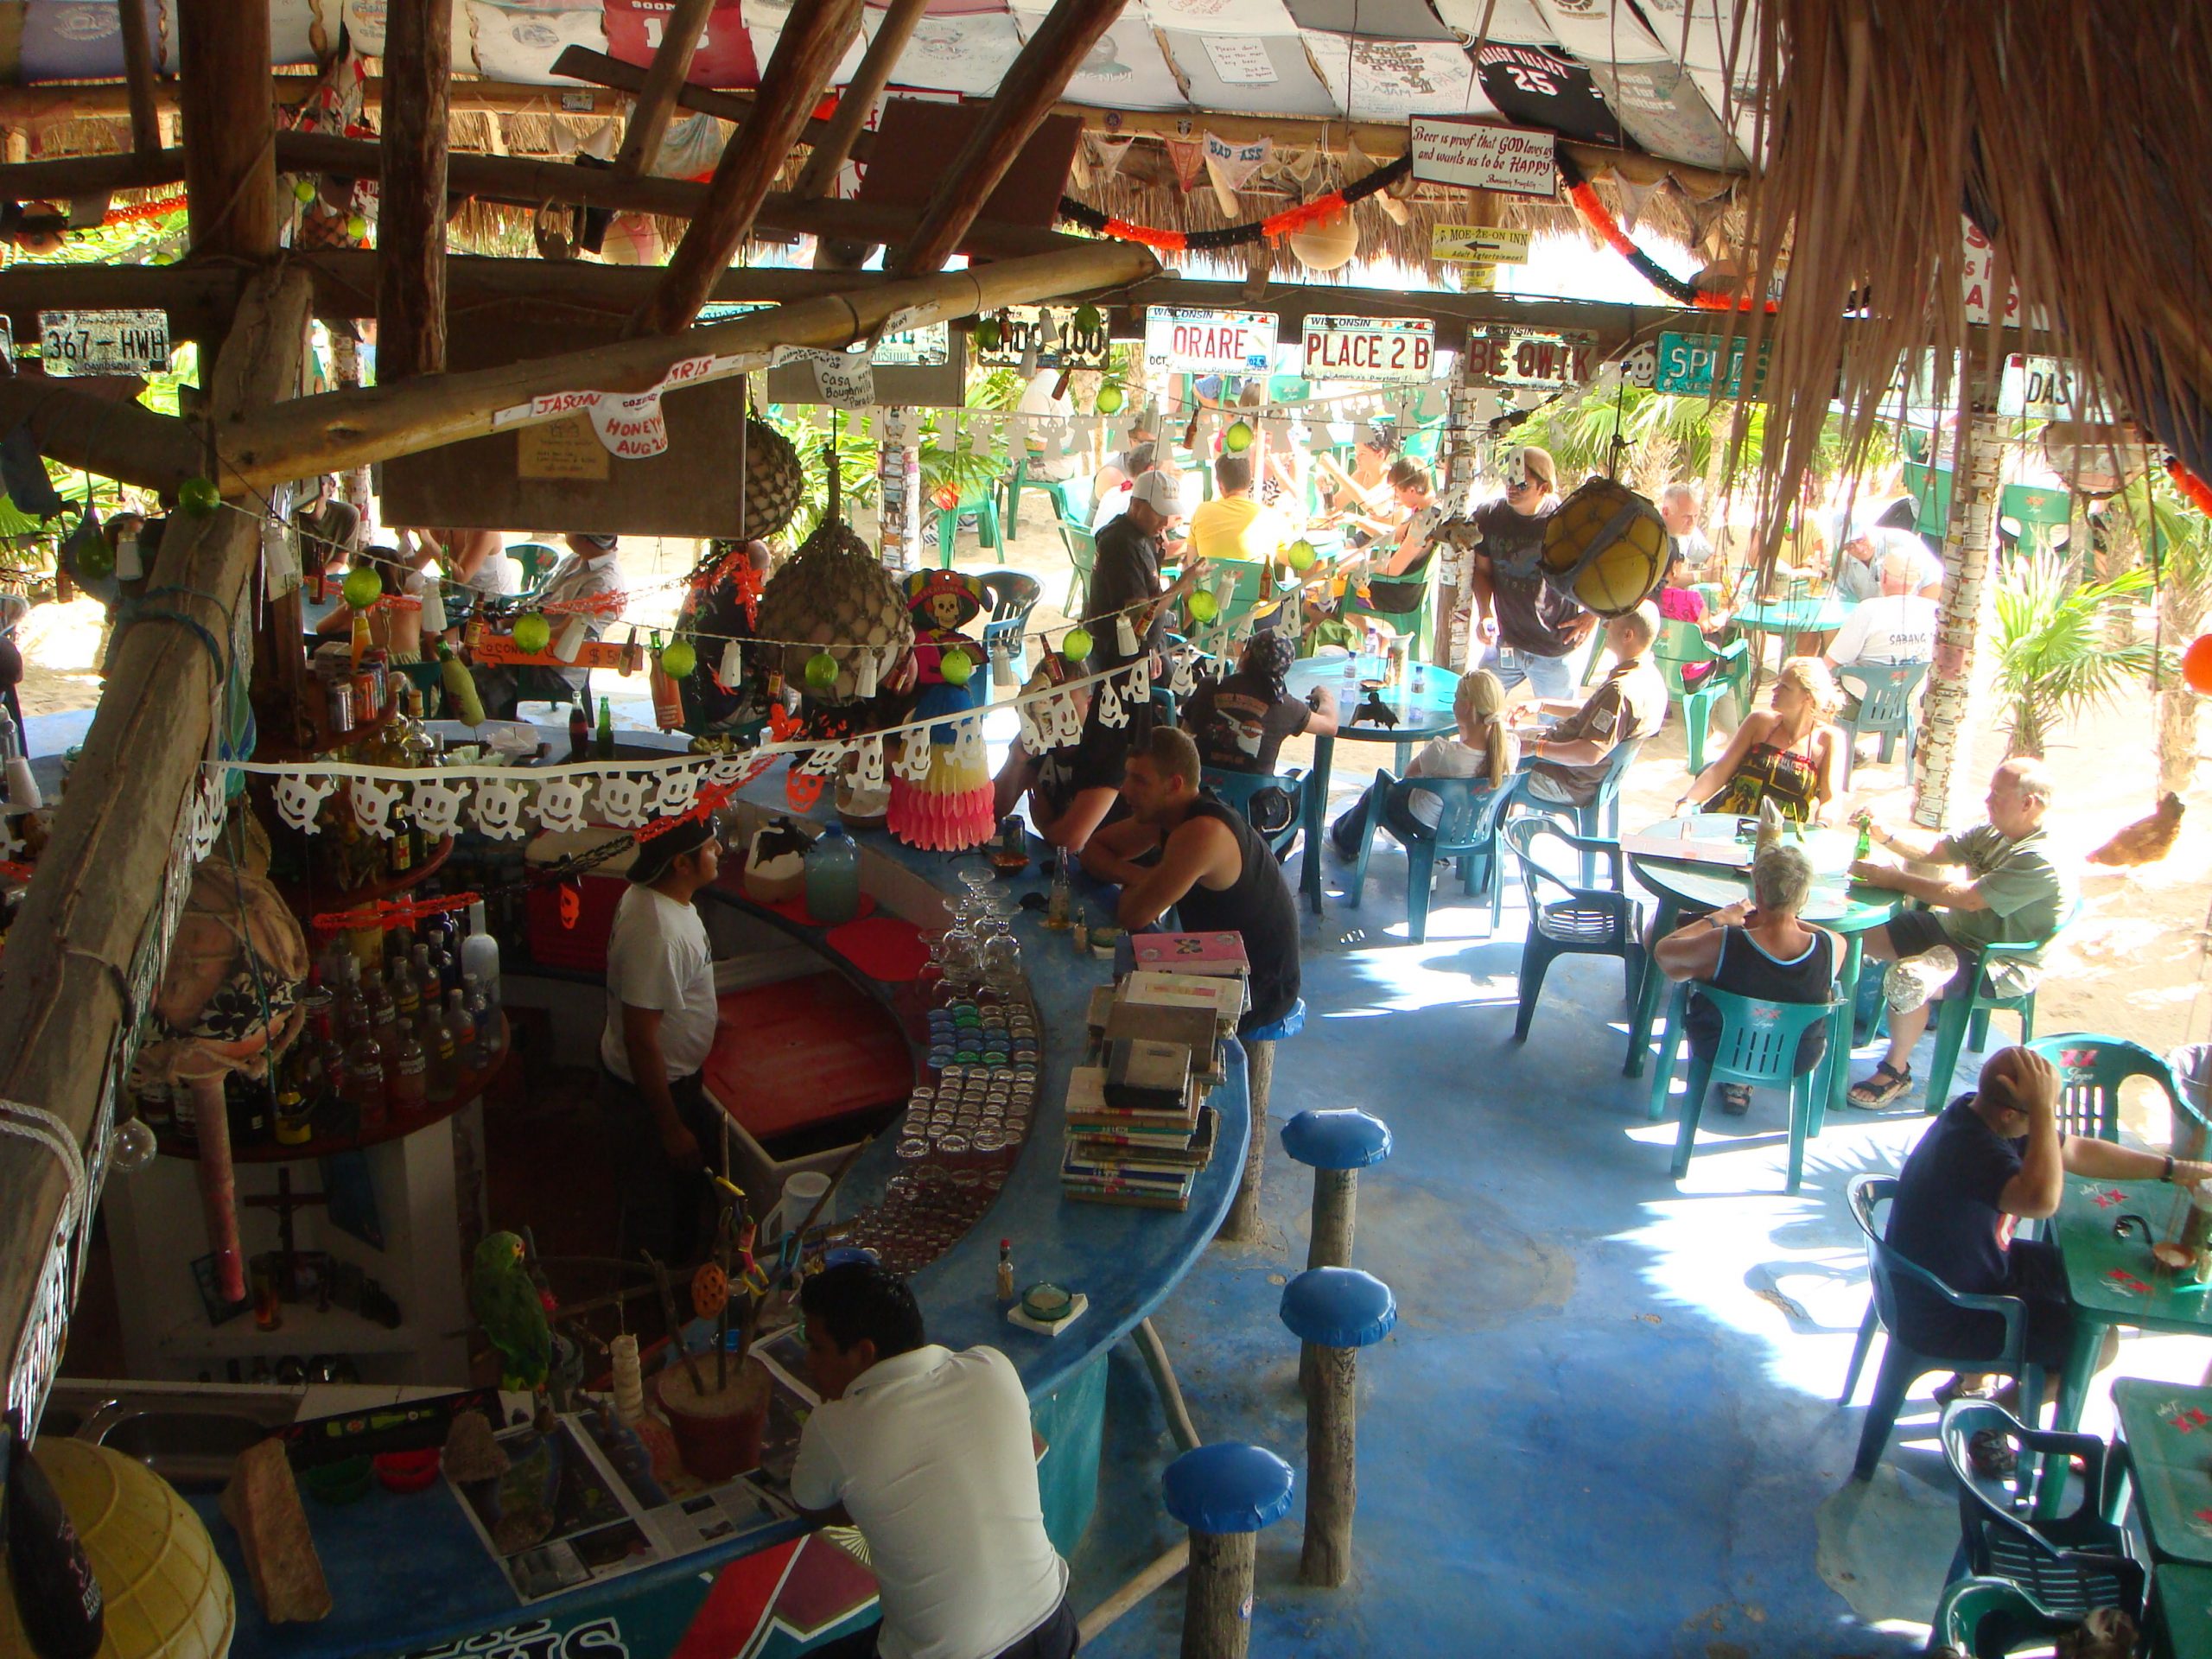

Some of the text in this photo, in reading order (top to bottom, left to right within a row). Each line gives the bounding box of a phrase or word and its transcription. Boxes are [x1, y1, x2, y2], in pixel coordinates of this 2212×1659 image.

[632, 1, 677, 11] SOON
[1506, 66, 1558, 97] 25
[1413, 125, 1554, 158] Beer is proof that GOD loves us
[1210, 140, 1263, 162] BAD ASS
[1418, 148, 1434, 162] and
[1436, 150, 1465, 166] wants
[1466, 155, 1478, 168] us
[1481, 153, 1492, 169] to
[1493, 155, 1506, 170] be
[1510, 232, 1529, 247] INN
[1452, 250, 1471, 258] Adult
[1154, 307, 1214, 320] WISCONSIN
[1311, 317, 1371, 327] WISCONSIN
[1173, 325, 1249, 360] ORARE
[1306, 333, 1430, 370] PLACE 2 B
[1149, 355, 1166, 365] OCT
[1470, 339, 1510, 378] BE
[536, 394, 602, 415] JASON
[616, 439, 652, 455] AUG
[1889, 632, 1927, 646] SABANG
